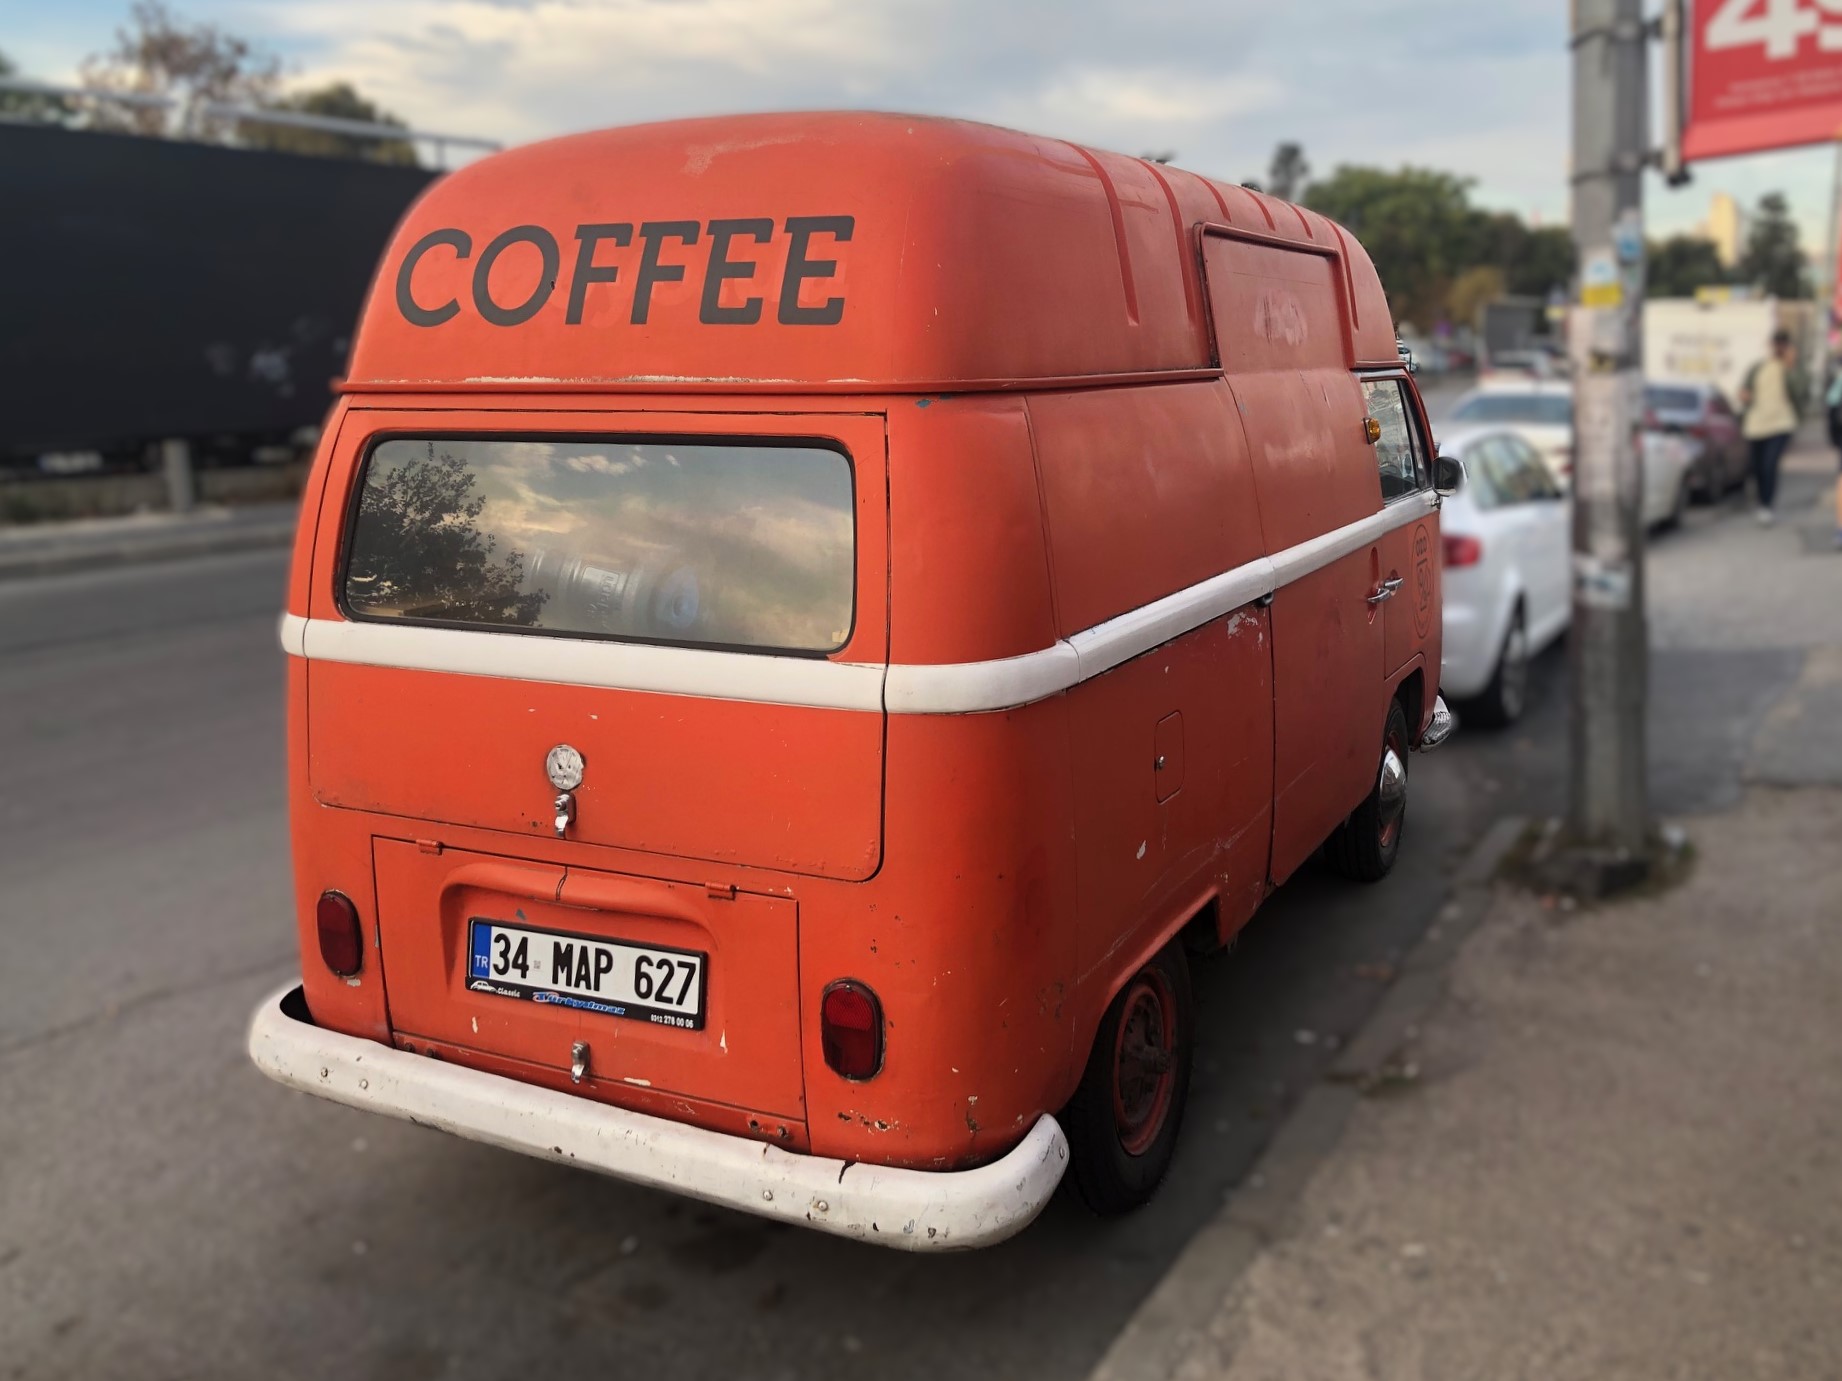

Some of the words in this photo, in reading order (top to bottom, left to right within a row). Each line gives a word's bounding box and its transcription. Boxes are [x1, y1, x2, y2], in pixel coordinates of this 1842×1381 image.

[396, 215, 855, 327] COFFEE
[475, 955, 489, 968] TR
[493, 934, 529, 979] 34
[552, 941, 614, 992] MAP
[634, 955, 697, 1006] 627
[497, 987, 521, 998] Classic
[676, 1017, 685, 1027] 00
